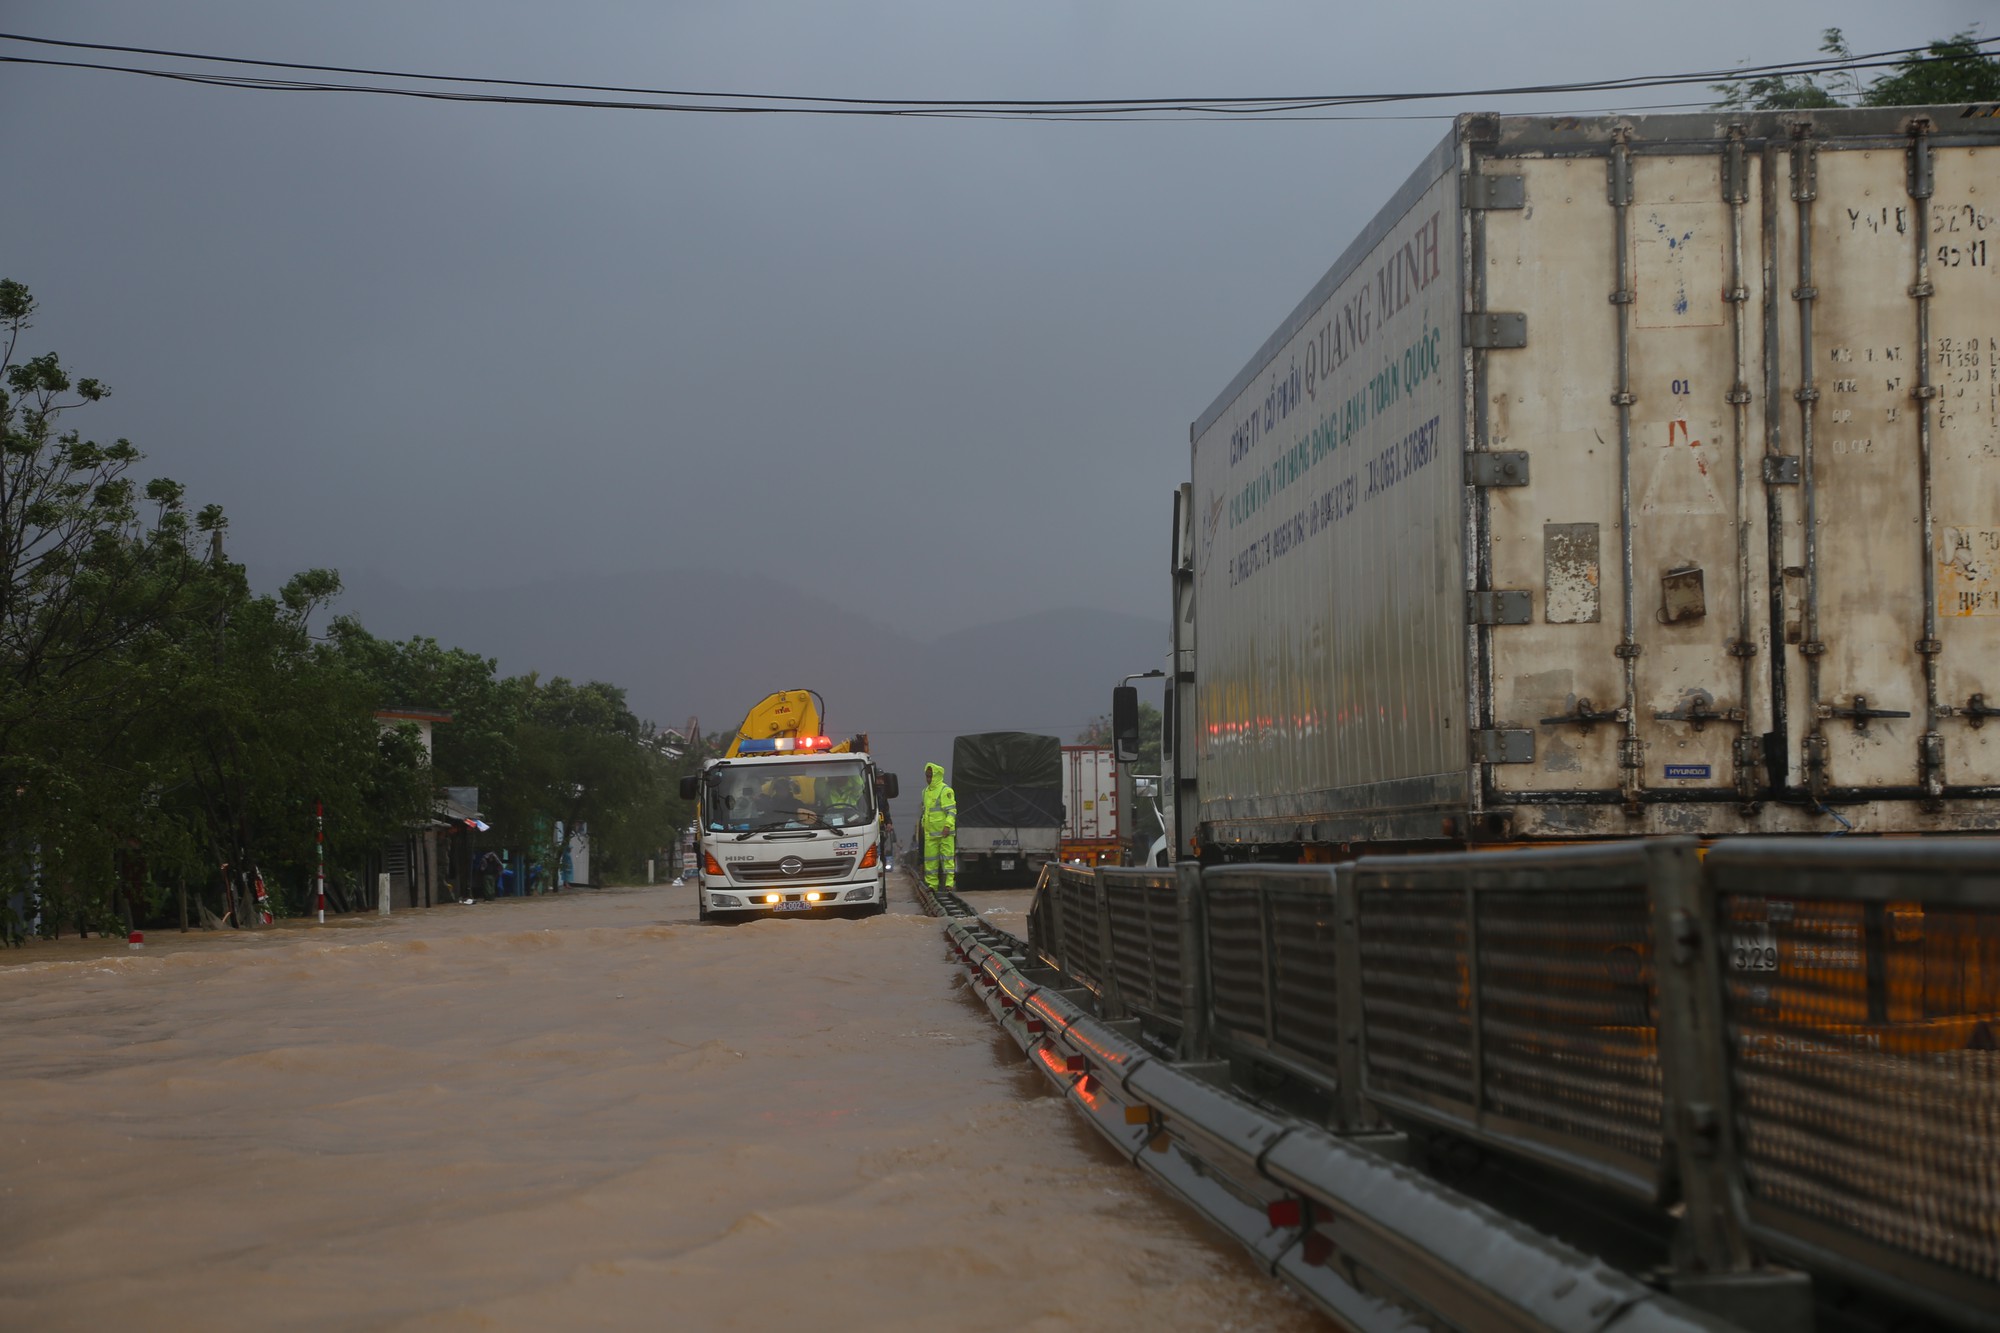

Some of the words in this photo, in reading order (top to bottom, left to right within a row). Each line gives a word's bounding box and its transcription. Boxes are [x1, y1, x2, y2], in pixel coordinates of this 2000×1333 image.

[1305, 284, 1371, 402] QUANG
[1376, 210, 1440, 331] MINH
[1671, 379, 1691, 395] 01
